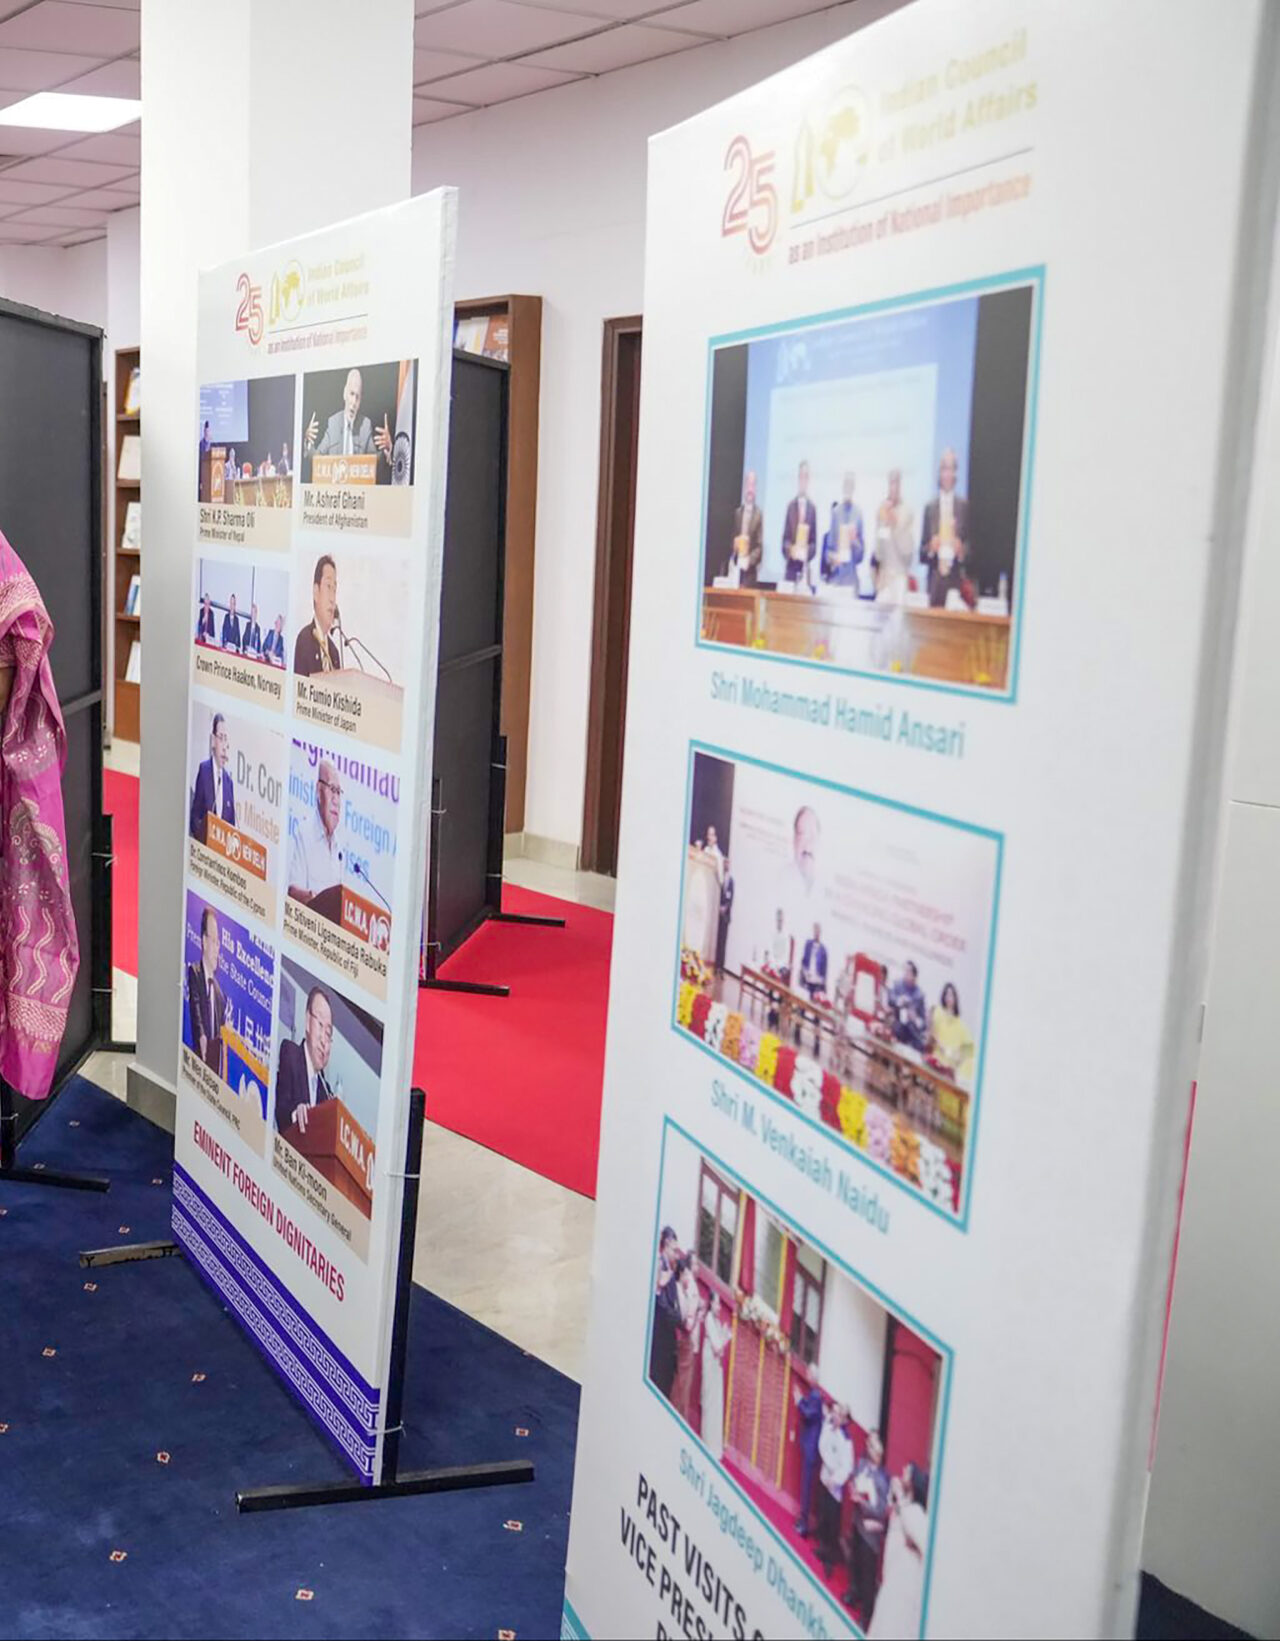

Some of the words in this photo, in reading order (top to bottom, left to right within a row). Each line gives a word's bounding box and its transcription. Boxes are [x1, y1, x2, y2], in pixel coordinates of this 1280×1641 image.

[945, 28, 1028, 90] Council
[962, 80, 1039, 131] Affairs
[720, 134, 779, 256] 25
[235, 272, 264, 346] 25
[332, 689, 362, 717] Kishida
[710, 671, 740, 703] Shri
[741, 676, 831, 726] Mohammad
[835, 696, 894, 742] Hamid
[896, 710, 967, 760] Ansari
[193, 1119, 231, 1178] EMINENT
[232, 1161, 275, 1226] FOREIGN
[275, 1207, 346, 1303] DIGNITARIES
[710, 1078, 738, 1114] Shri
[740, 1099, 757, 1137] M.
[761, 1112, 832, 1195] Venkaiah
[838, 1168, 891, 1235] Naidu
[621, 1506, 657, 1587] VICE
[659, 1564, 714, 1640] PRES
[637, 1473, 681, 1555] PAST
[684, 1533, 747, 1640] VISITS
[679, 1447, 705, 1497] Shri
[706, 1484, 764, 1575] Jagdeep
[766, 1555, 832, 1640] Dhankh
